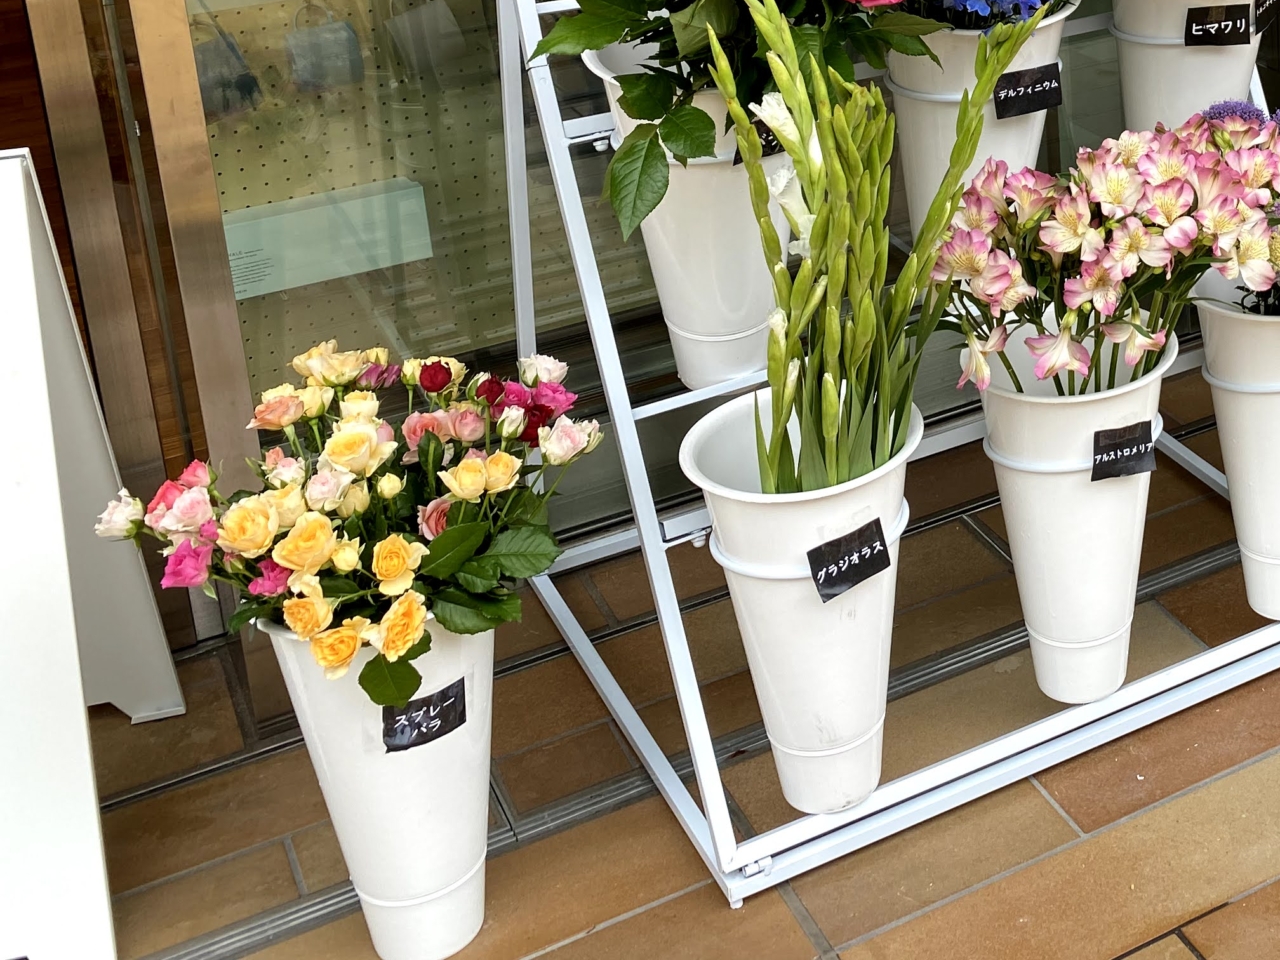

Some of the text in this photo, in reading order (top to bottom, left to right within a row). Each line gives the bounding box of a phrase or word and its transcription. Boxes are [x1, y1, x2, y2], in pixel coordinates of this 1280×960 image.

[1191, 18, 1246, 35] ヒマワリ
[998, 79, 1059, 100] デルフィニウム
[1094, 442, 1154, 464] アルストロメリア
[817, 540, 884, 584] グラジオラス
[394, 697, 455, 728] スプレー
